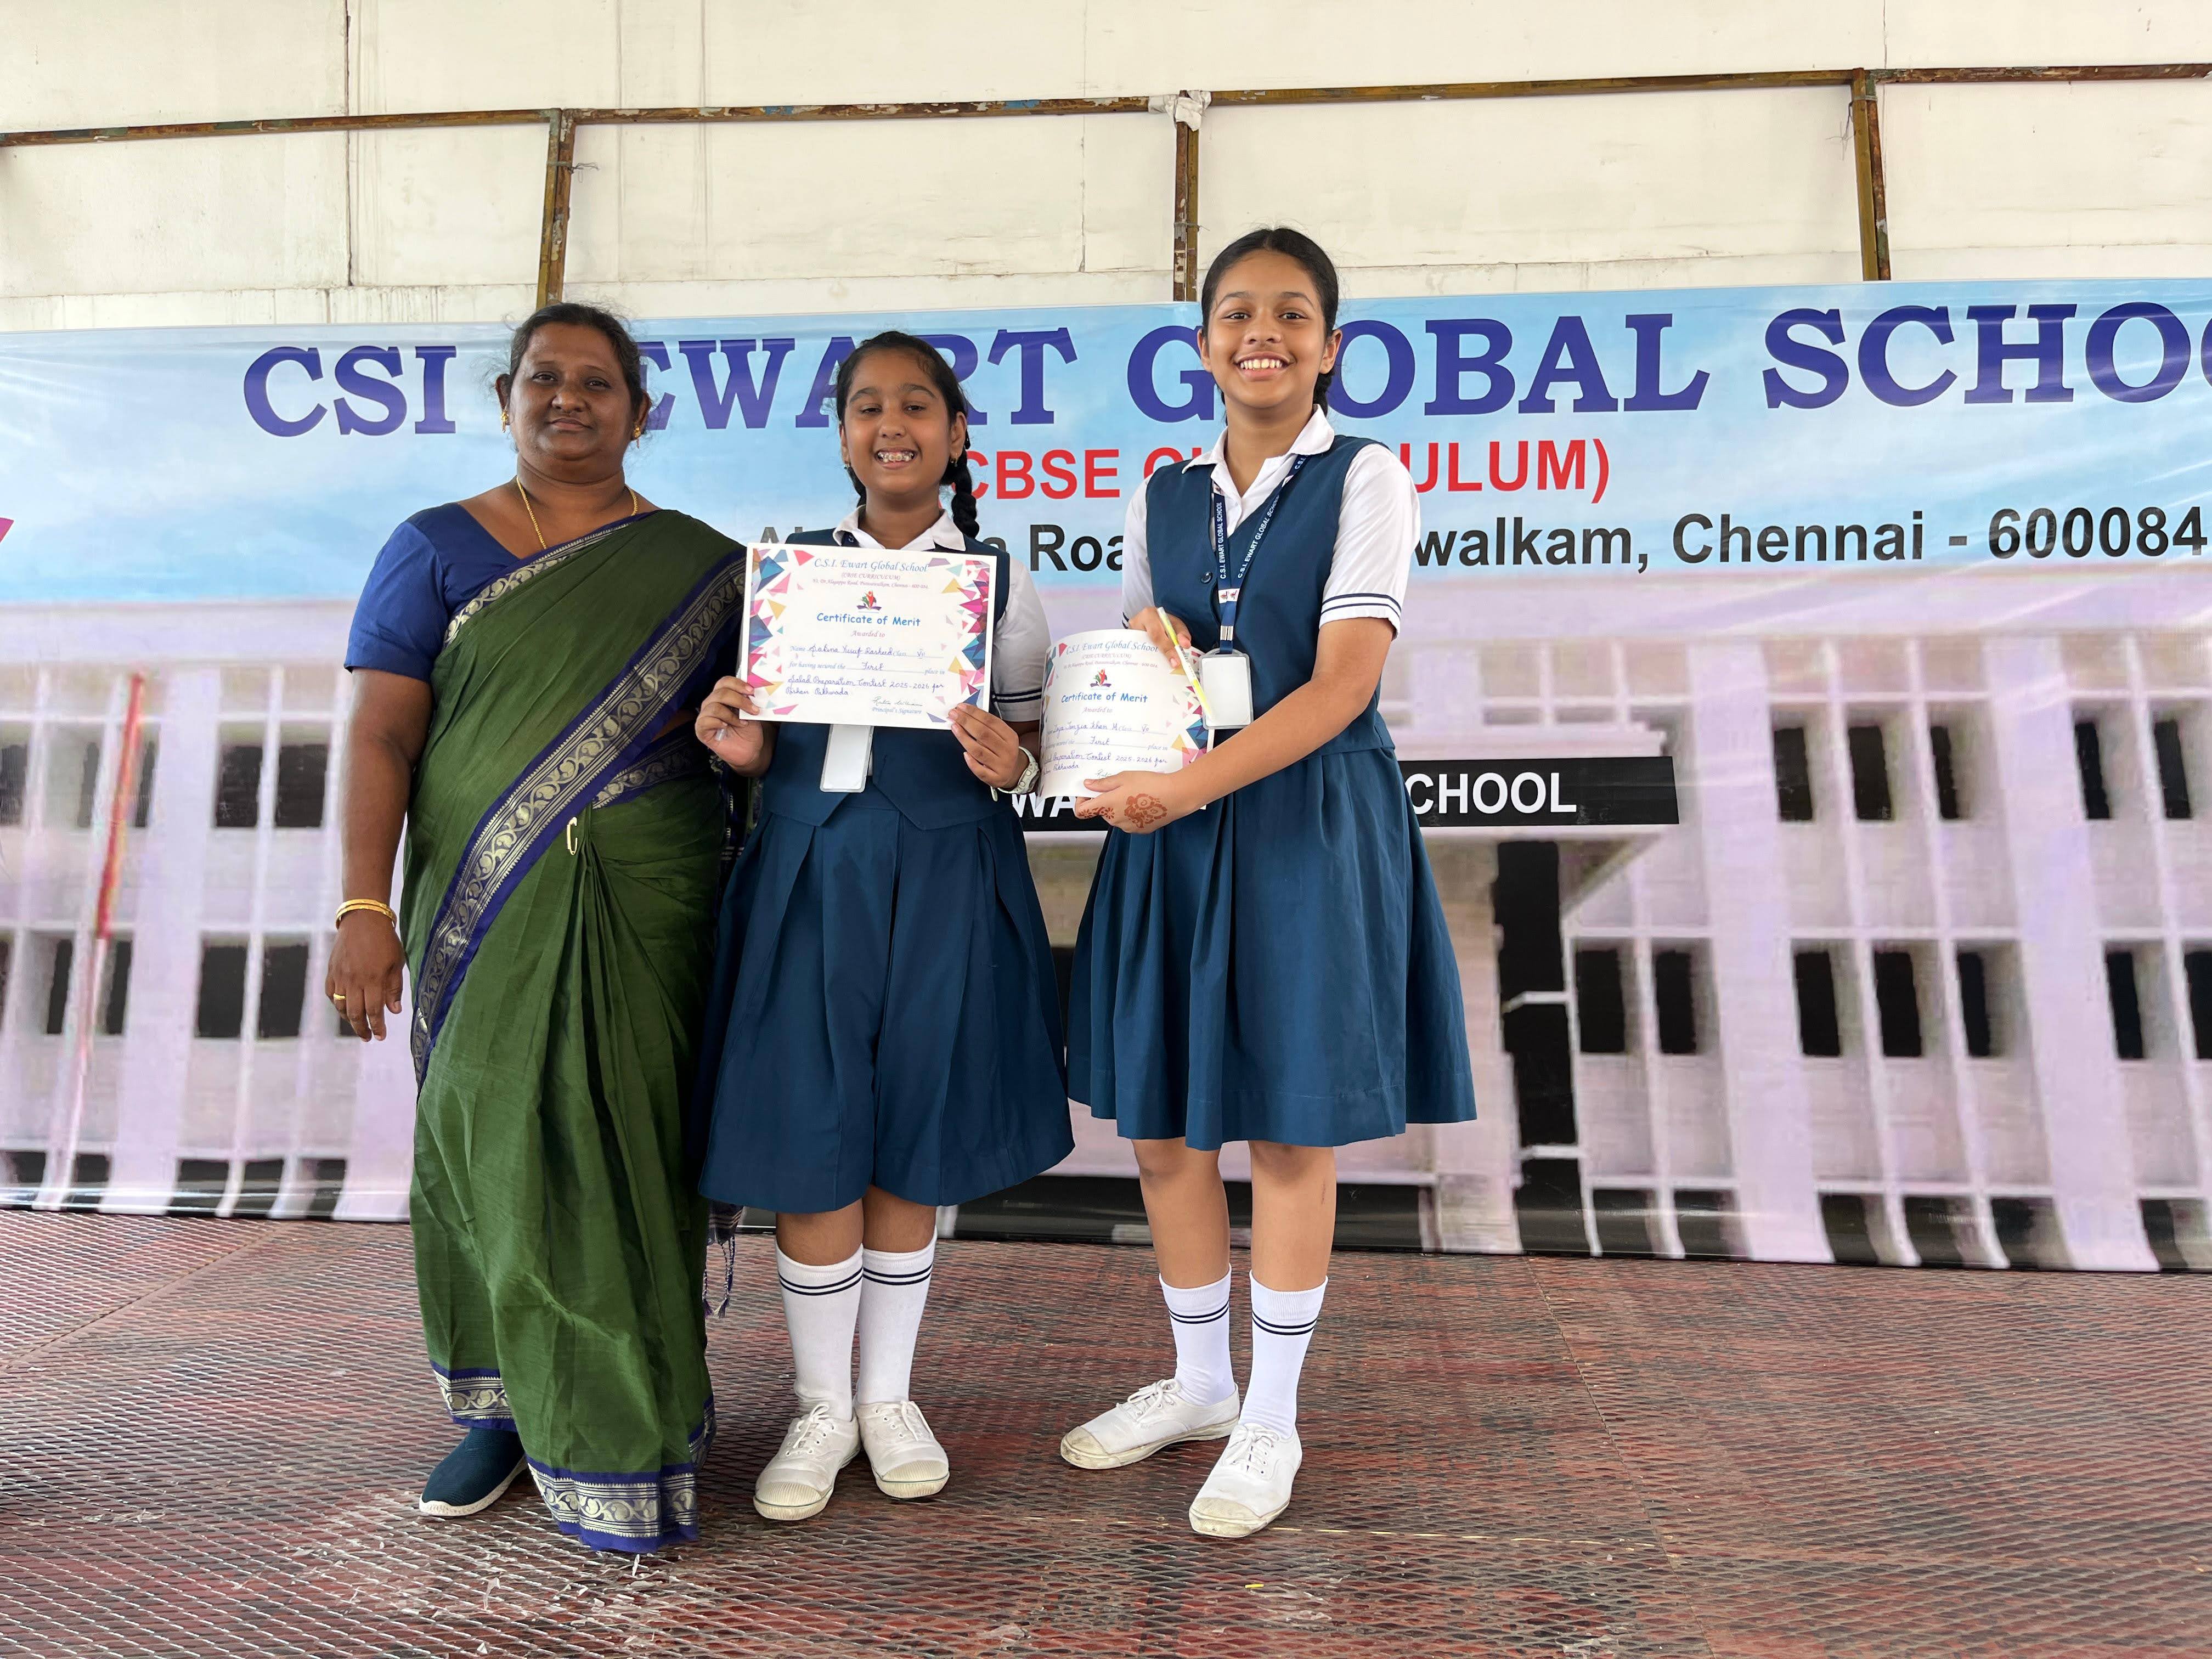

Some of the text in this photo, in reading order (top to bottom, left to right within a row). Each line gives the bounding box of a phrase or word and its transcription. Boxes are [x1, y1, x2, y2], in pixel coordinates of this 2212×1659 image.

[244, 346, 456, 437] CSI
[1127, 313, 1710, 423] GOBAL
[1762, 302, 2212, 409] SCHO
[1030, 524, 1123, 571] Roa
[1673, 511, 1923, 563] Chennai
[1949, 535, 1967, 546] -
[1989, 506, 2208, 560] 600084
[1244, 540, 1258, 562] EWART
[1255, 517, 1269, 540] GLOBAL
[1267, 494, 1279, 517] SCHOOL
[814, 558, 929, 572] C.S.I. Ewart Global School
[817, 612, 921, 627] Certificate of Merit
[1082, 642, 1103, 651] Ewart
[1105, 641, 1131, 651] Global
[1132, 641, 1159, 652] School
[1061, 692, 1148, 703] Certificate of Merit
[1404, 772, 1577, 815] CHOOL
